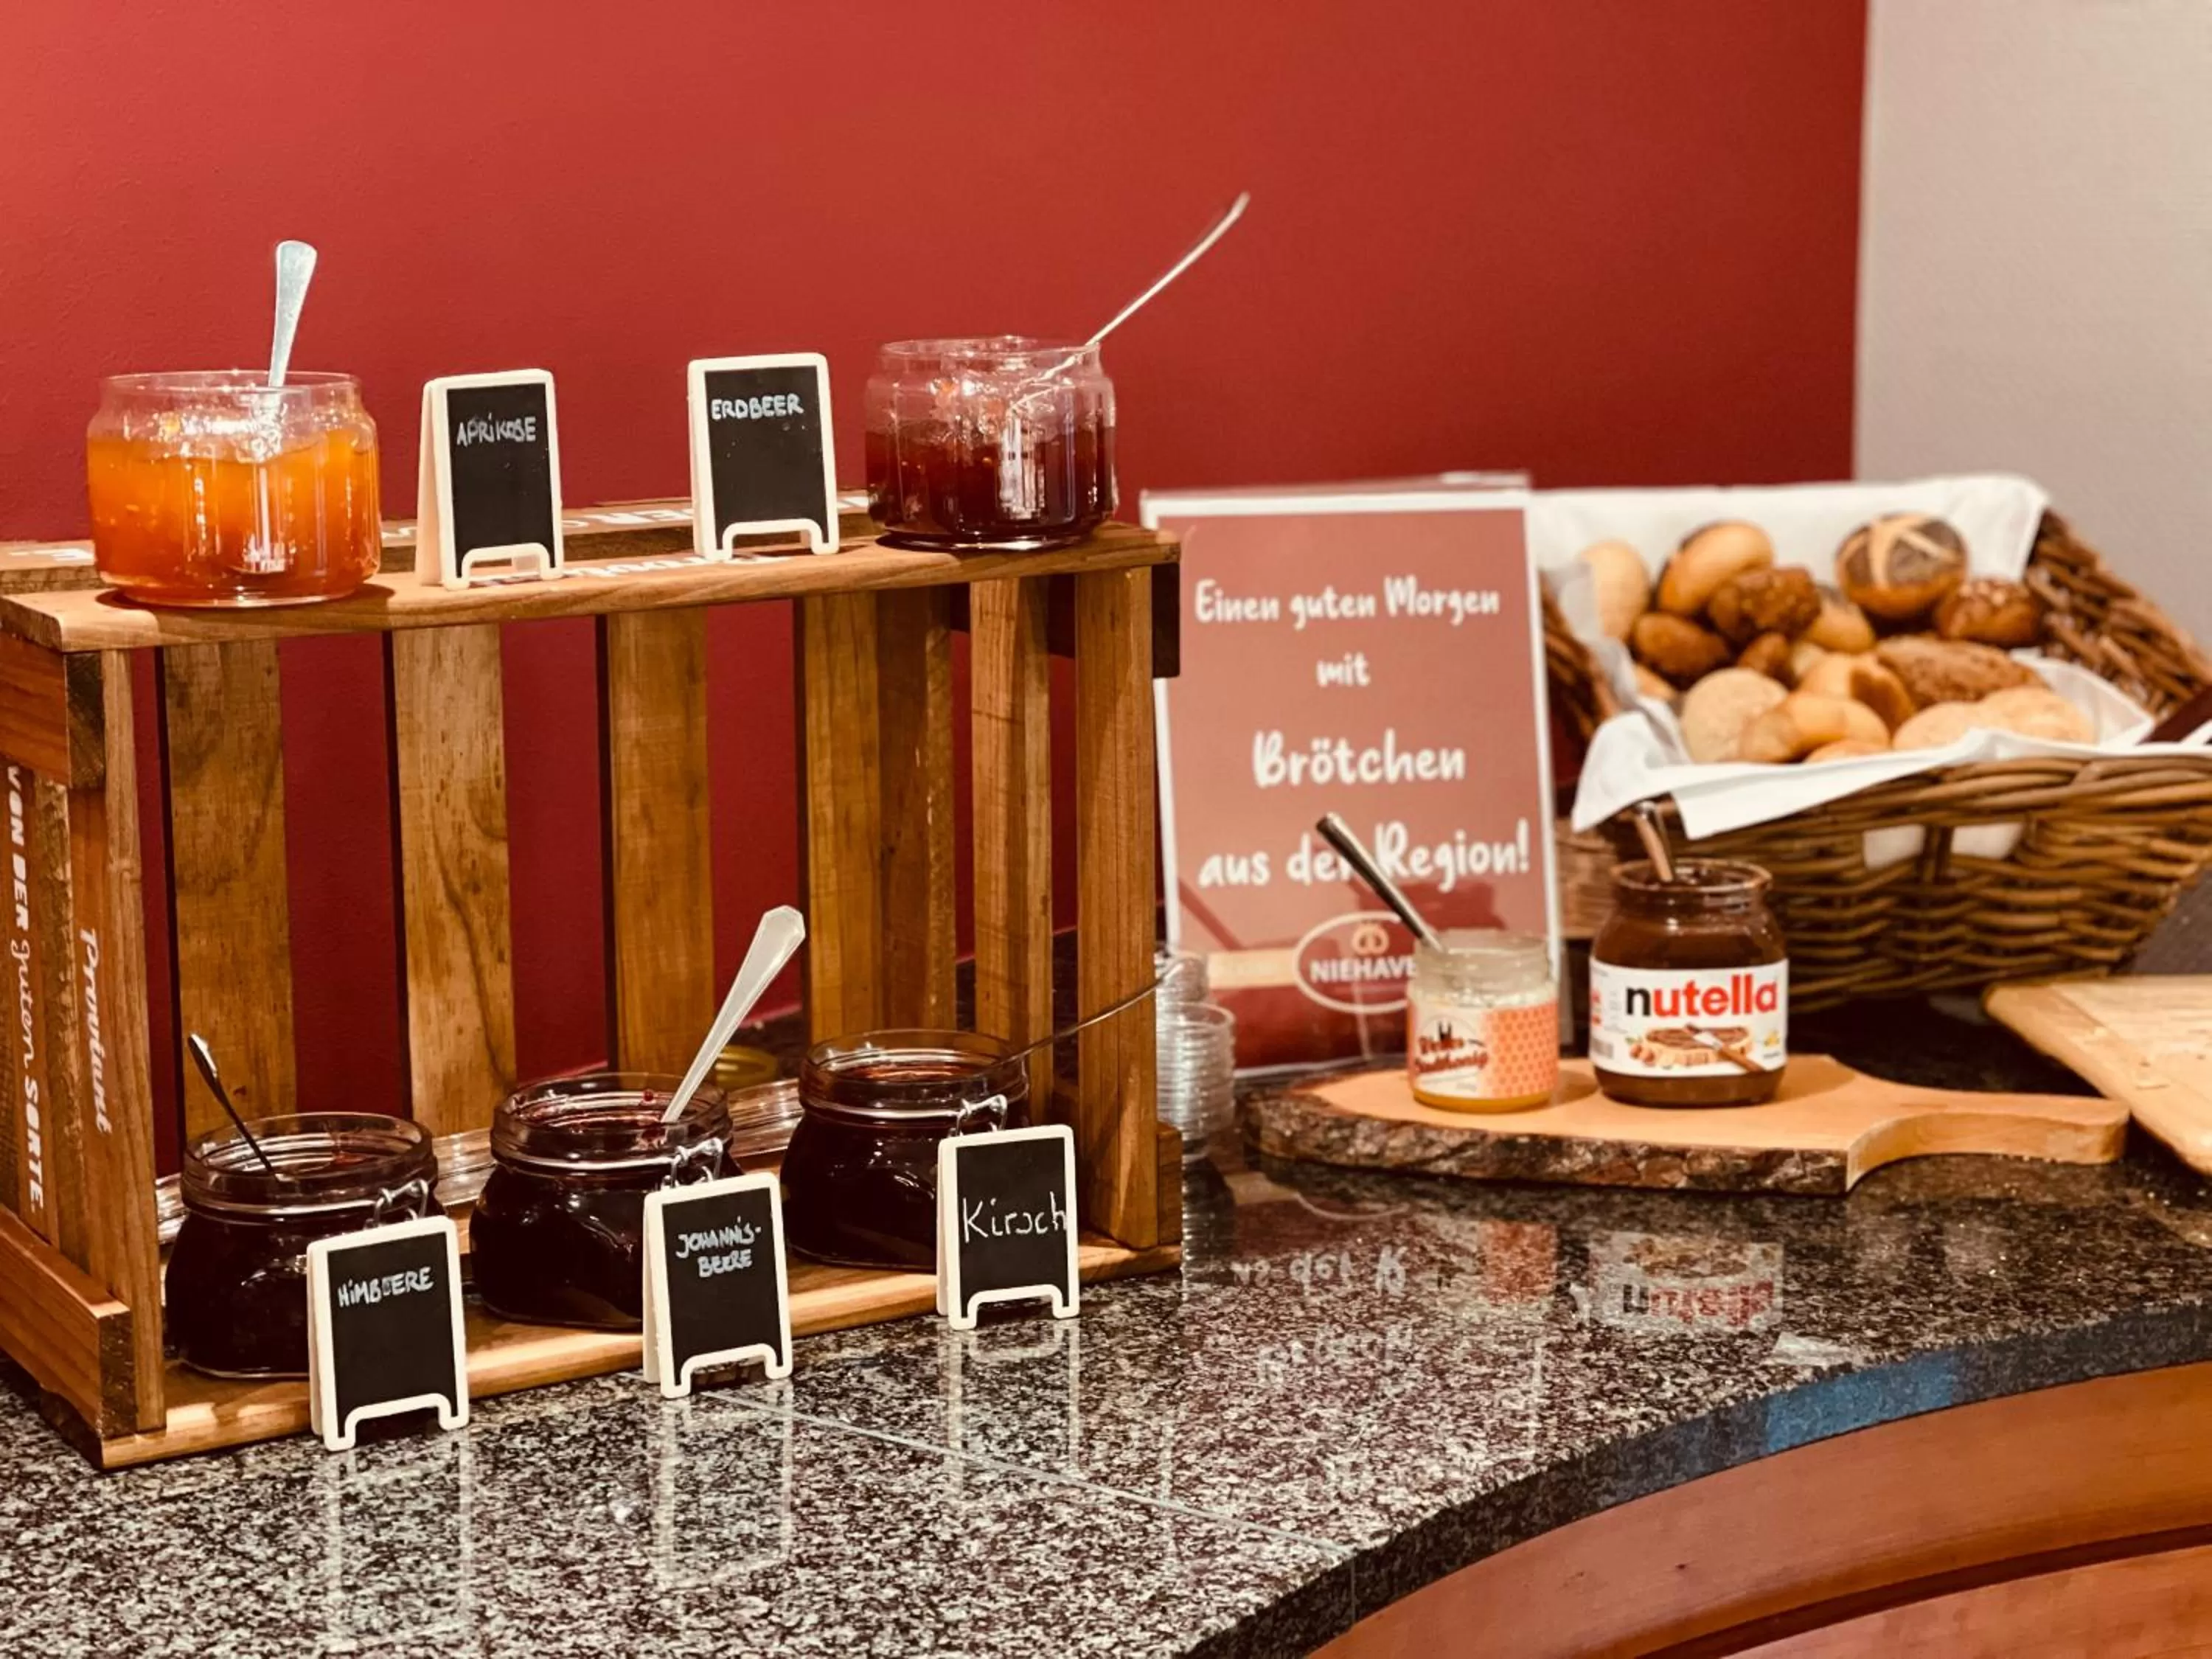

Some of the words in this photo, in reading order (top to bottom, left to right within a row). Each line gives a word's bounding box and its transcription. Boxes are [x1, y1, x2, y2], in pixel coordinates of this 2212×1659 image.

[711, 393, 804, 420] ERDBEER
[1194, 579, 1279, 622] Einen
[1290, 587, 1376, 630] guten
[1383, 574, 1500, 626] Morgen
[1315, 653, 1370, 686] mit
[1253, 728, 1466, 789] Brötchen
[7, 766, 24, 846] VON
[1198, 850, 1270, 888] aus
[1373, 818, 1529, 893] Region!
[13, 853, 29, 931] DER
[1310, 956, 1416, 983] NIEHAVE
[1625, 973, 1778, 1017] nutella
[10, 939, 34, 1069] guten
[80, 928, 112, 1134] Proviant
[962, 1191, 1067, 1244] Kirsch
[698, 1248, 753, 1278] BEERE
